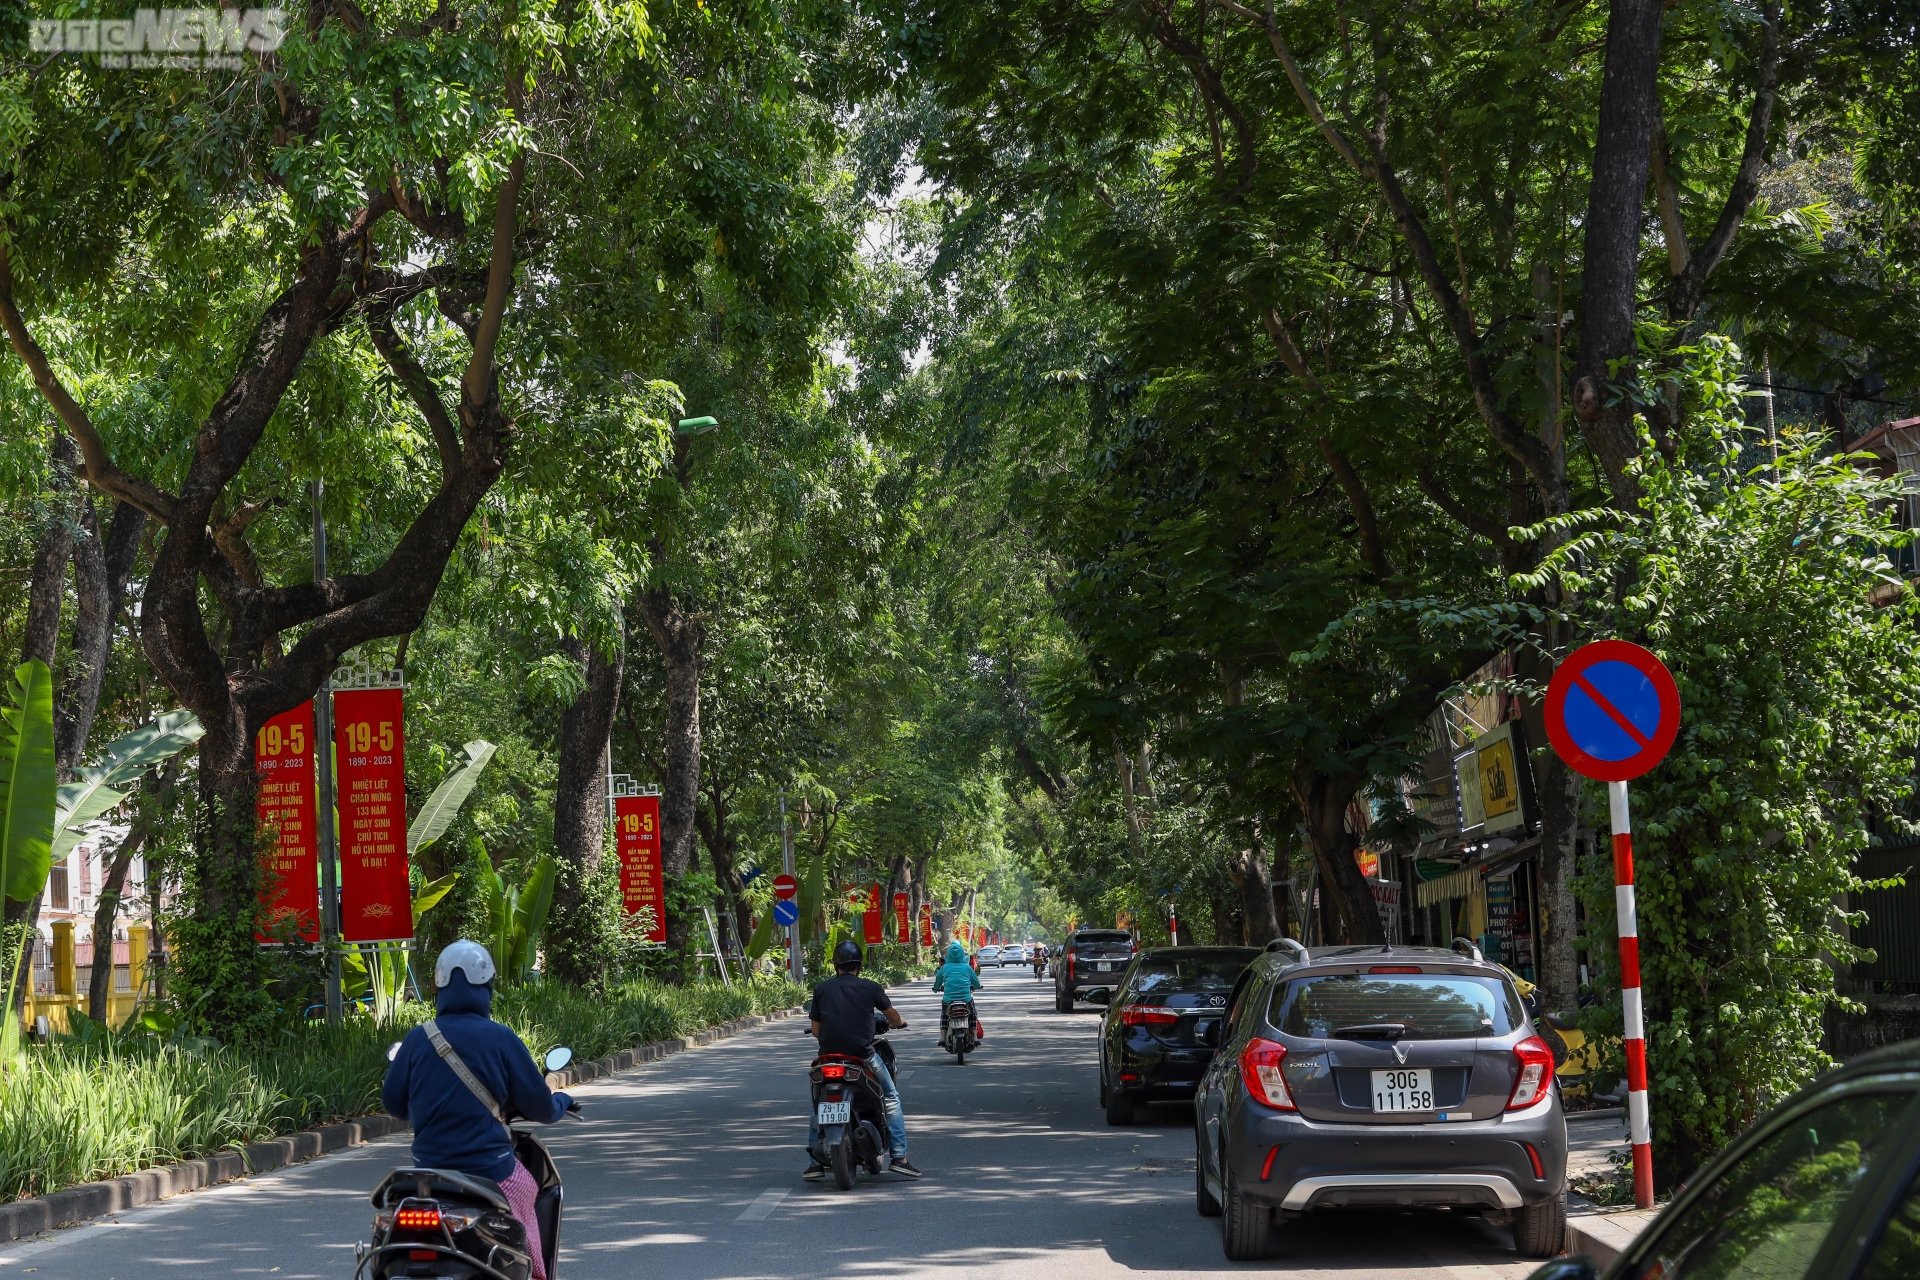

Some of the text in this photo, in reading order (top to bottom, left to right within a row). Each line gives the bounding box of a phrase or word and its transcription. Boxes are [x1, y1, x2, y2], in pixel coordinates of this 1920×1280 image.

[258, 724, 304, 756] 19-5
[345, 722, 394, 752] 19-5
[259, 760, 278, 769] 1890
[284, 758, 304, 768] 2023
[348, 756, 367, 767] 1890
[373, 755, 393, 765] 2023
[263, 780, 301, 795] NHIỆT LIỆT
[352, 777, 389, 792] NHIỆT LIỆT
[281, 794, 304, 806] MỪNG
[350, 790, 392, 803] CHÀO MỪNG
[356, 804, 387, 816] 133 NĂM
[284, 821, 302, 831] SINH
[353, 818, 391, 829] NGÀY SINH
[623, 814, 653, 832] 19-5
[282, 834, 300, 846] TỊCH
[357, 829, 389, 843] CHỦ TỊCH
[286, 846, 306, 857] MINH
[351, 842, 396, 855] HỒ CHÍ MINH
[370, 857, 383, 869] ĐẠI
[1386, 1072, 1418, 1090] 30G
[1377, 1091, 1431, 1110] 111.58
[821, 1113, 847, 1122] 119.00
